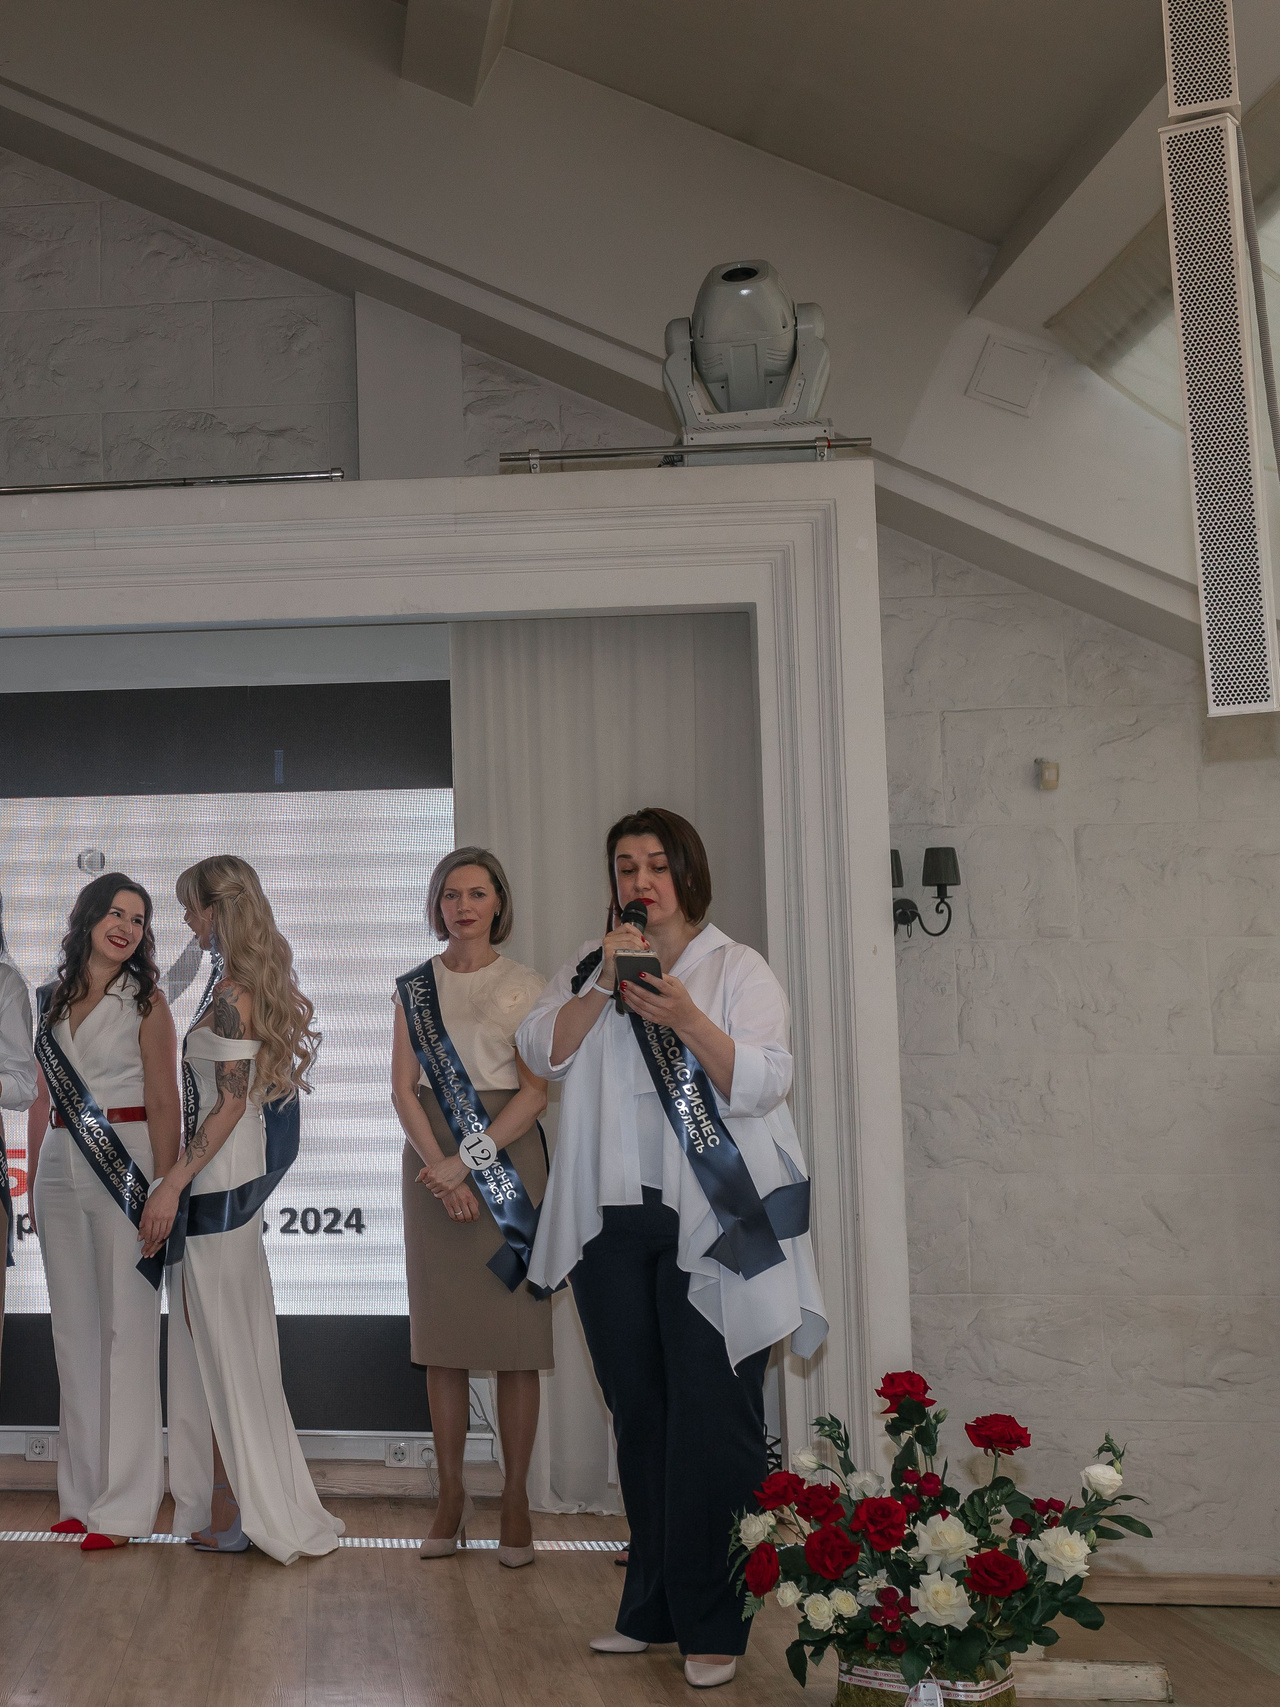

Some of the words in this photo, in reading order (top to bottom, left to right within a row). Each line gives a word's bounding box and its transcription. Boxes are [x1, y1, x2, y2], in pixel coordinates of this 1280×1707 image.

[413, 1012, 439, 1078] НОВОСИБИРСК
[421, 1009, 463, 1093] ФИНАЛИСТКА
[456, 1092, 485, 1135] МИСС
[490, 1156, 517, 1201] ИЗНЕС
[438, 1075, 445, 1085] И
[441, 1083, 470, 1139] НОВОСИБИР
[642, 1017, 681, 1099] ВОСИБИРСКАЯ
[675, 1099, 705, 1154] ОБЛАСТЬ
[35, 1041, 64, 1101] НОВОСИБИРСК
[60, 1098, 69, 1107] И
[65, 1103, 112, 1176] НОВОСИБИРСКАЯ
[109, 1170, 138, 1211] ОБЛАСТЬ
[41, 1035, 85, 1112] ФИНАЛИСТКА
[81, 1110, 118, 1161] МИССИС
[112, 1155, 148, 1204] БИЗНЕС
[682, 1082, 720, 1148] БИЗНЕС
[464, 1136, 492, 1167] 12
[481, 1168, 504, 1205] БЛАСТЬ
[279, 1207, 365, 1235] 2024
